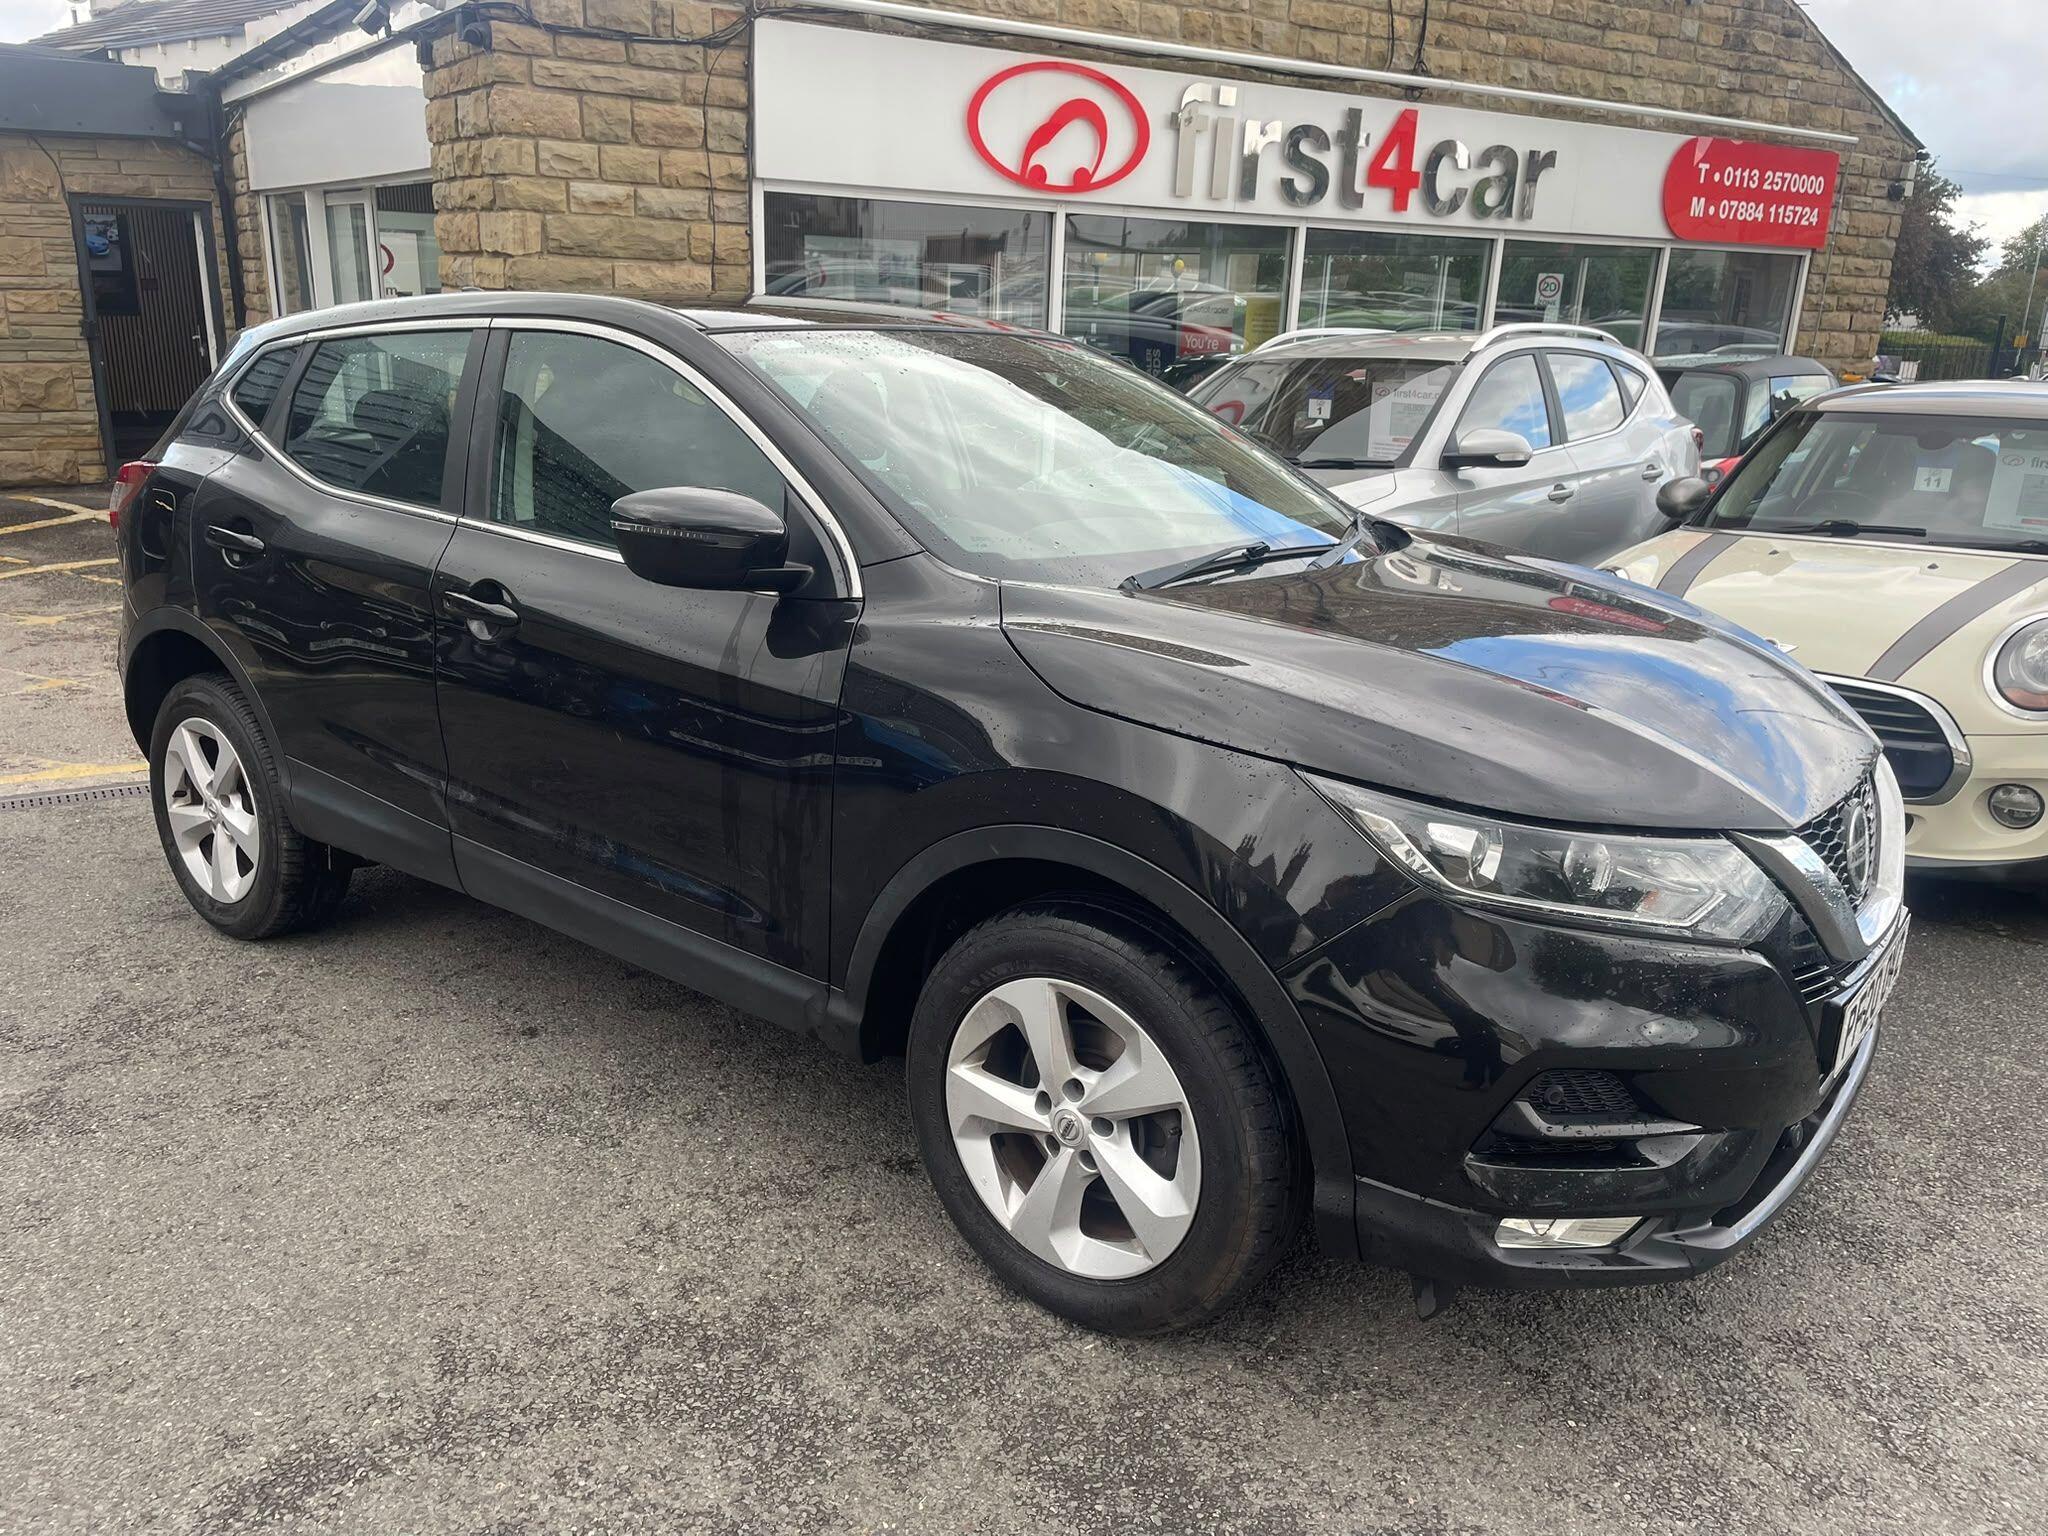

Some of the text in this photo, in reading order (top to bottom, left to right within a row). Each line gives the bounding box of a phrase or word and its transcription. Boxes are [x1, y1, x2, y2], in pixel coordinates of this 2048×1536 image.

[1170, 82, 1558, 221] first4car
[1698, 163, 1825, 196] T 0113 2570000
[1690, 197, 1819, 227] M 07884 115724
[1542, 282, 1557, 292] 20
[1185, 334, 1219, 350] You're
[1923, 476, 1942, 489] 11
